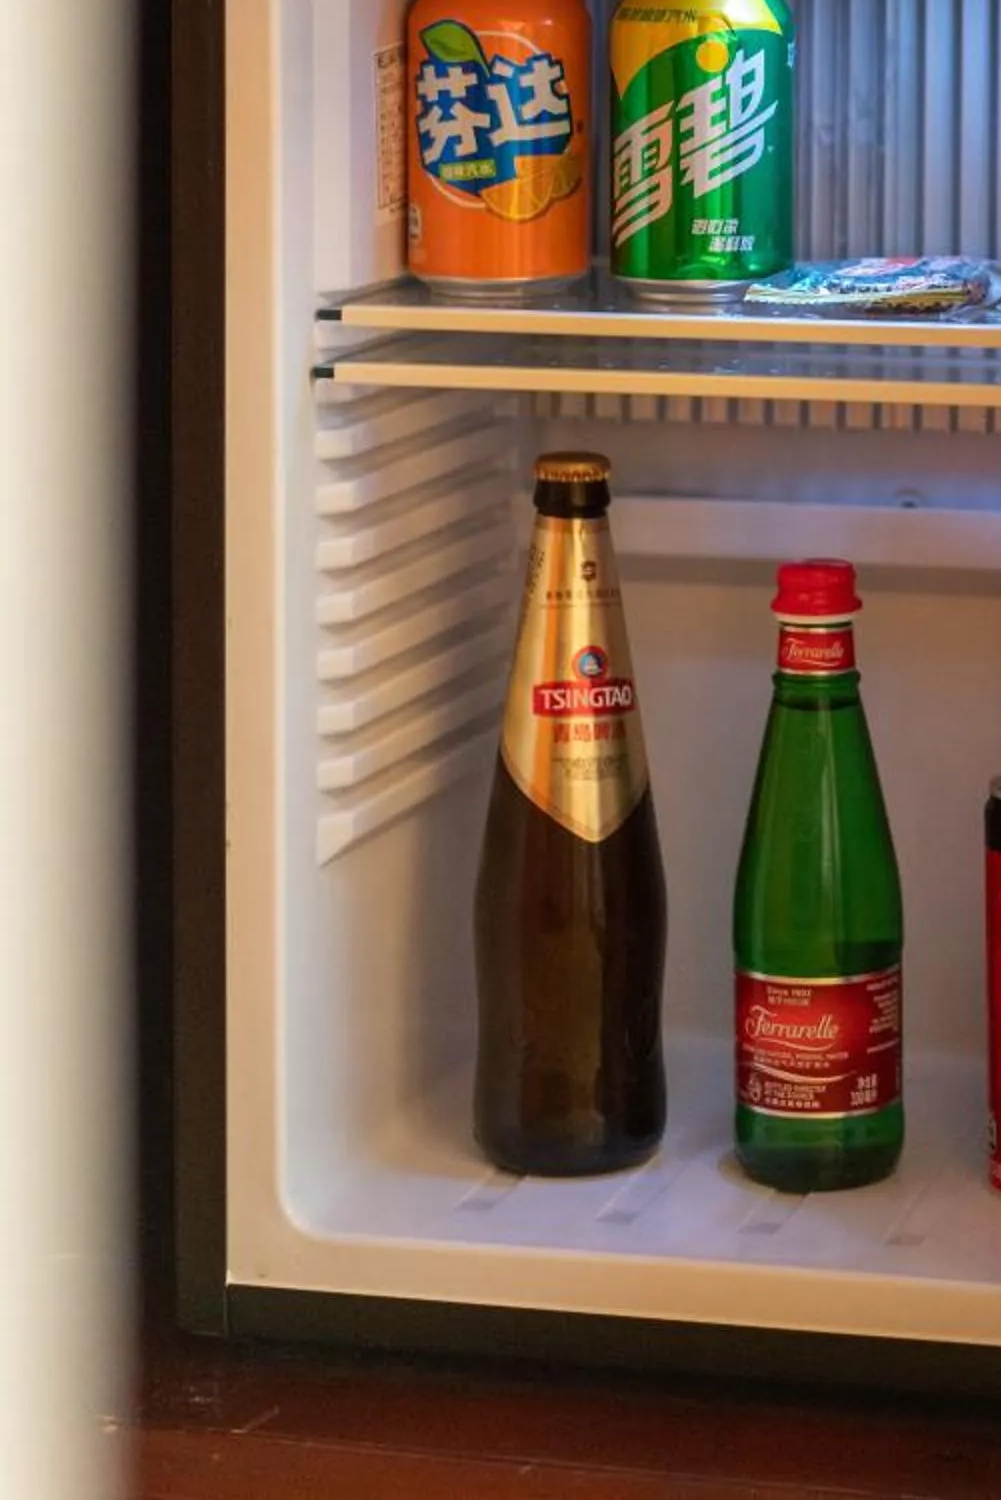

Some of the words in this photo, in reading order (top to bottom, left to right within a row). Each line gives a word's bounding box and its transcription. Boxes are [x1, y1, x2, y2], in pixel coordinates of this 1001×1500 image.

[417, 58, 571, 164] 芬达
[613, 49, 778, 248] 雪碧
[540, 685, 632, 711] TSINGTAO
[744, 1005, 839, 1040] Ferrarelle
